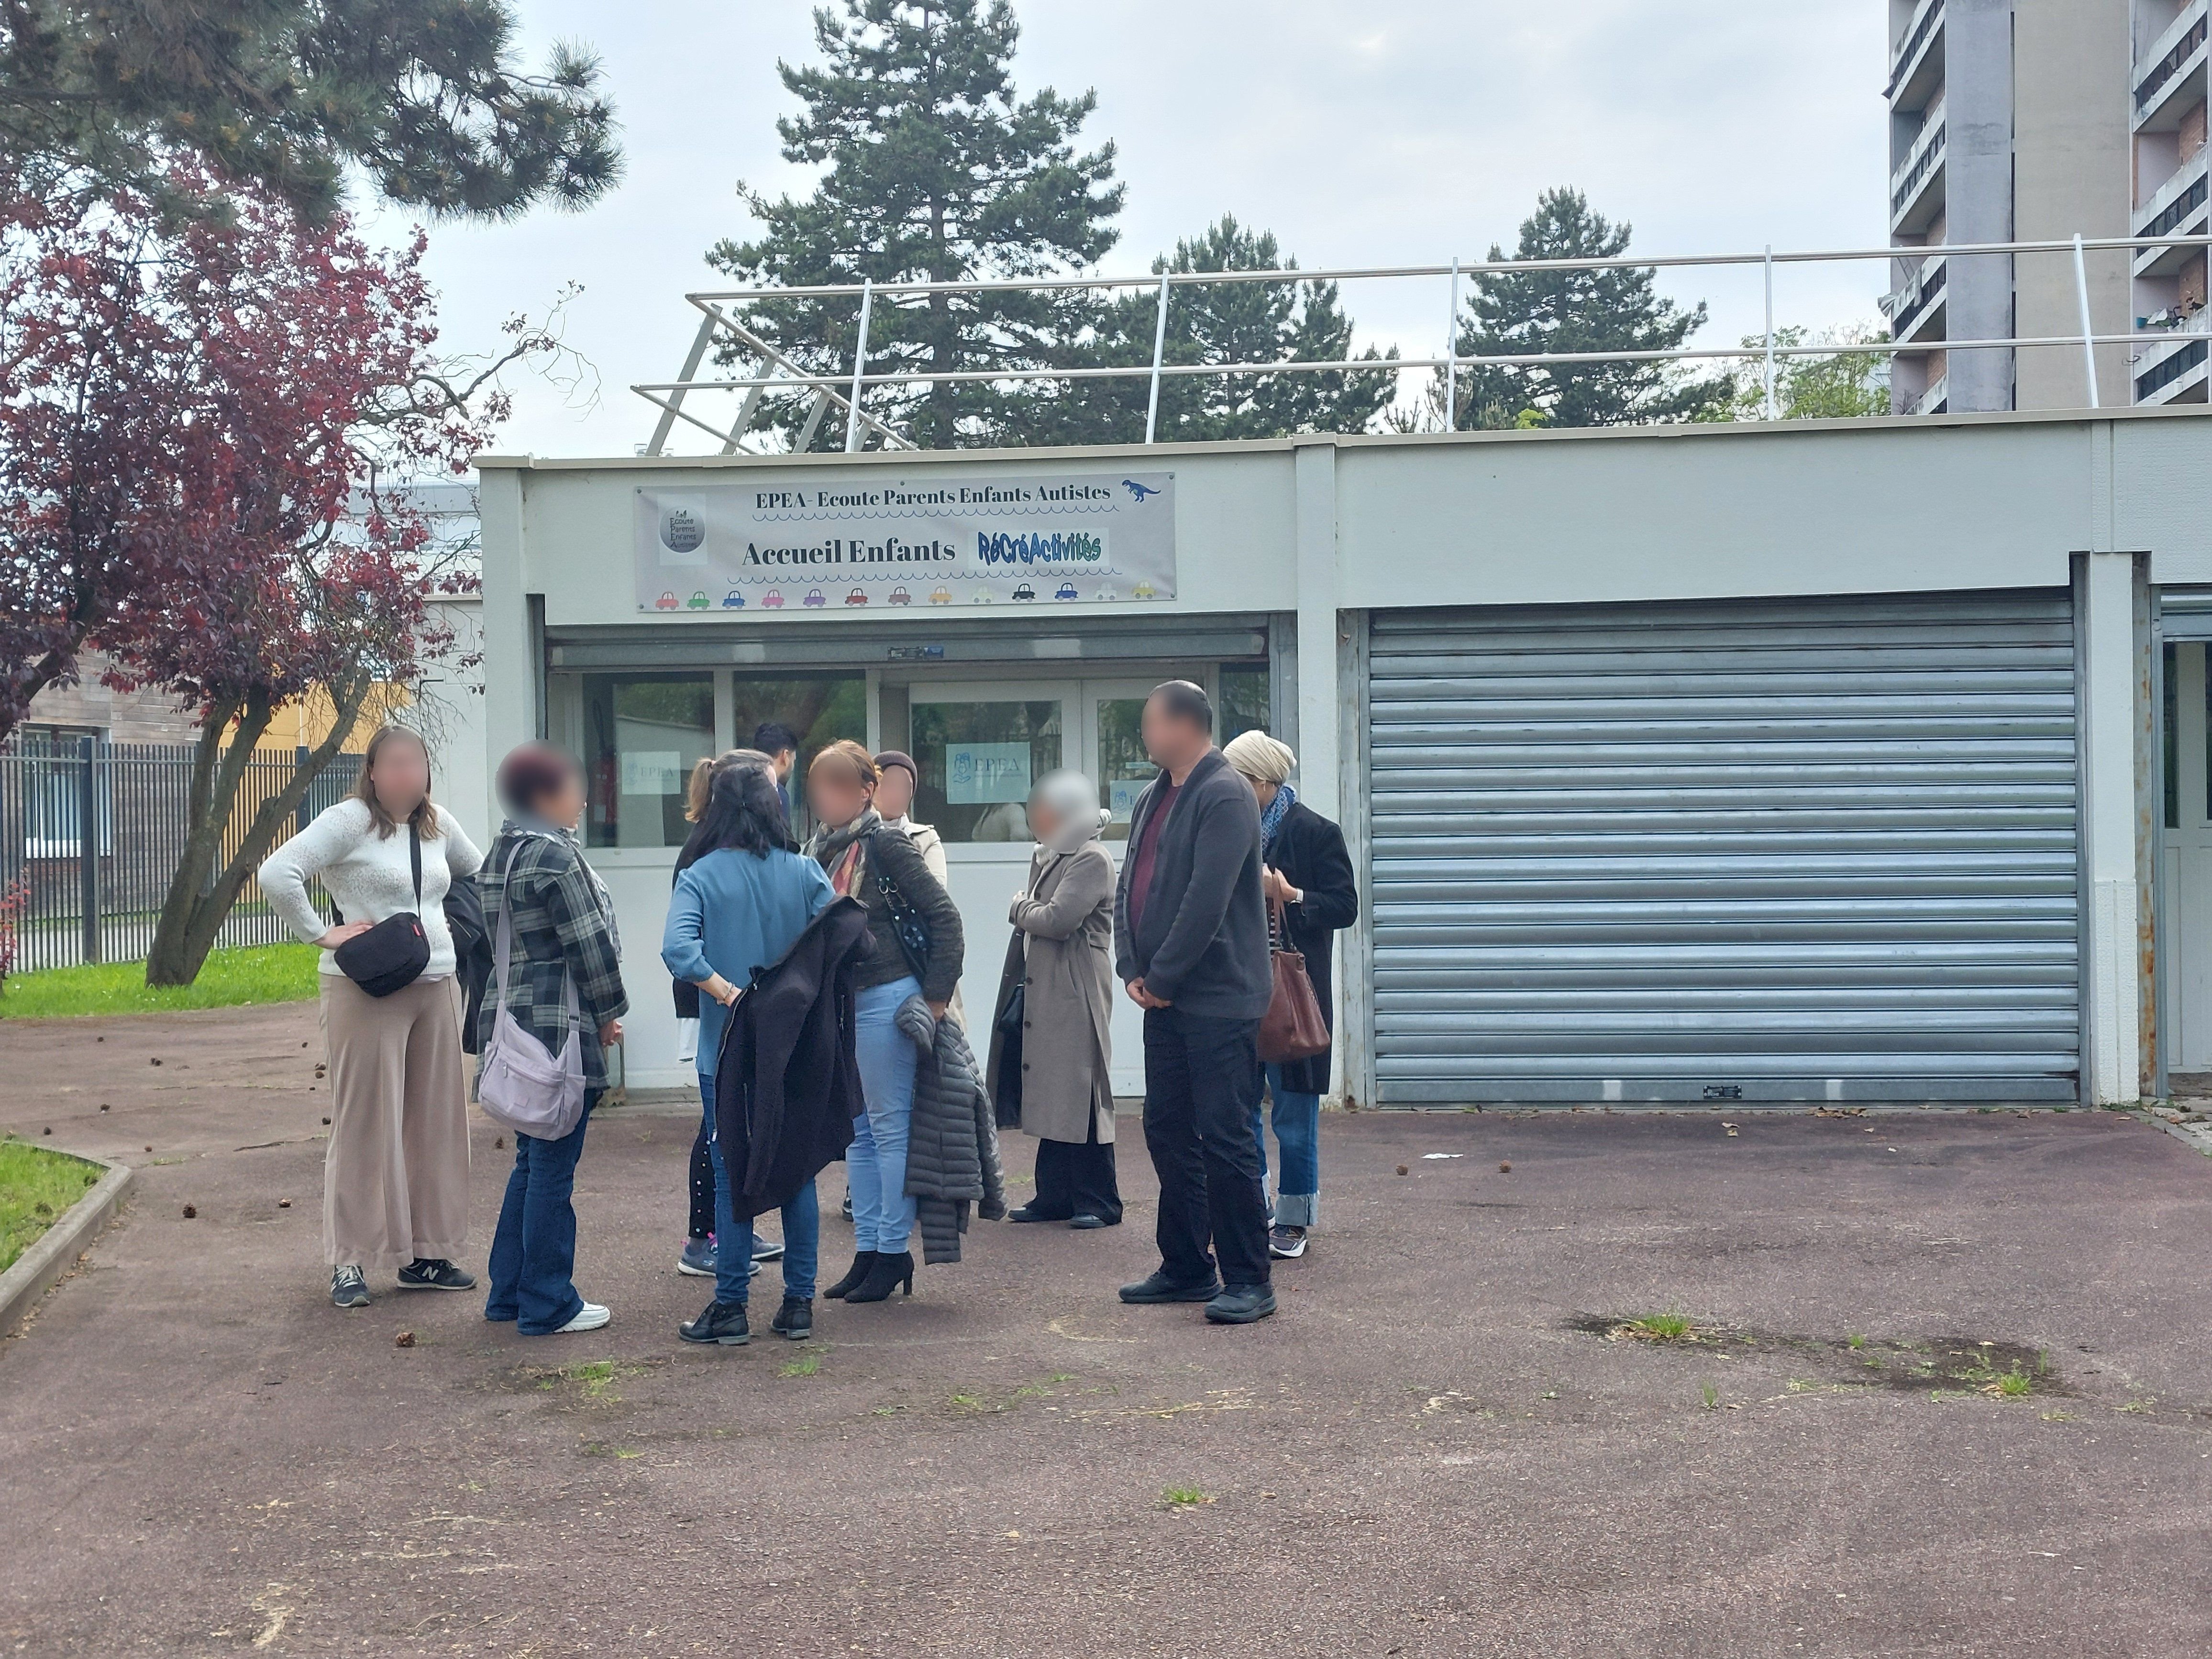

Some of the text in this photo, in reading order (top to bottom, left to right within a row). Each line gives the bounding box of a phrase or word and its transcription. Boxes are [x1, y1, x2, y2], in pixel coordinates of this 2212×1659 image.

[818, 491, 880, 507] Ecoute
[884, 489, 955, 506] Parents
[959, 486, 1031, 503] Enfants
[1035, 484, 1111, 501] Autistes
[741, 537, 956, 565] Accueil Enfants
[422, 1266, 439, 1280] N
